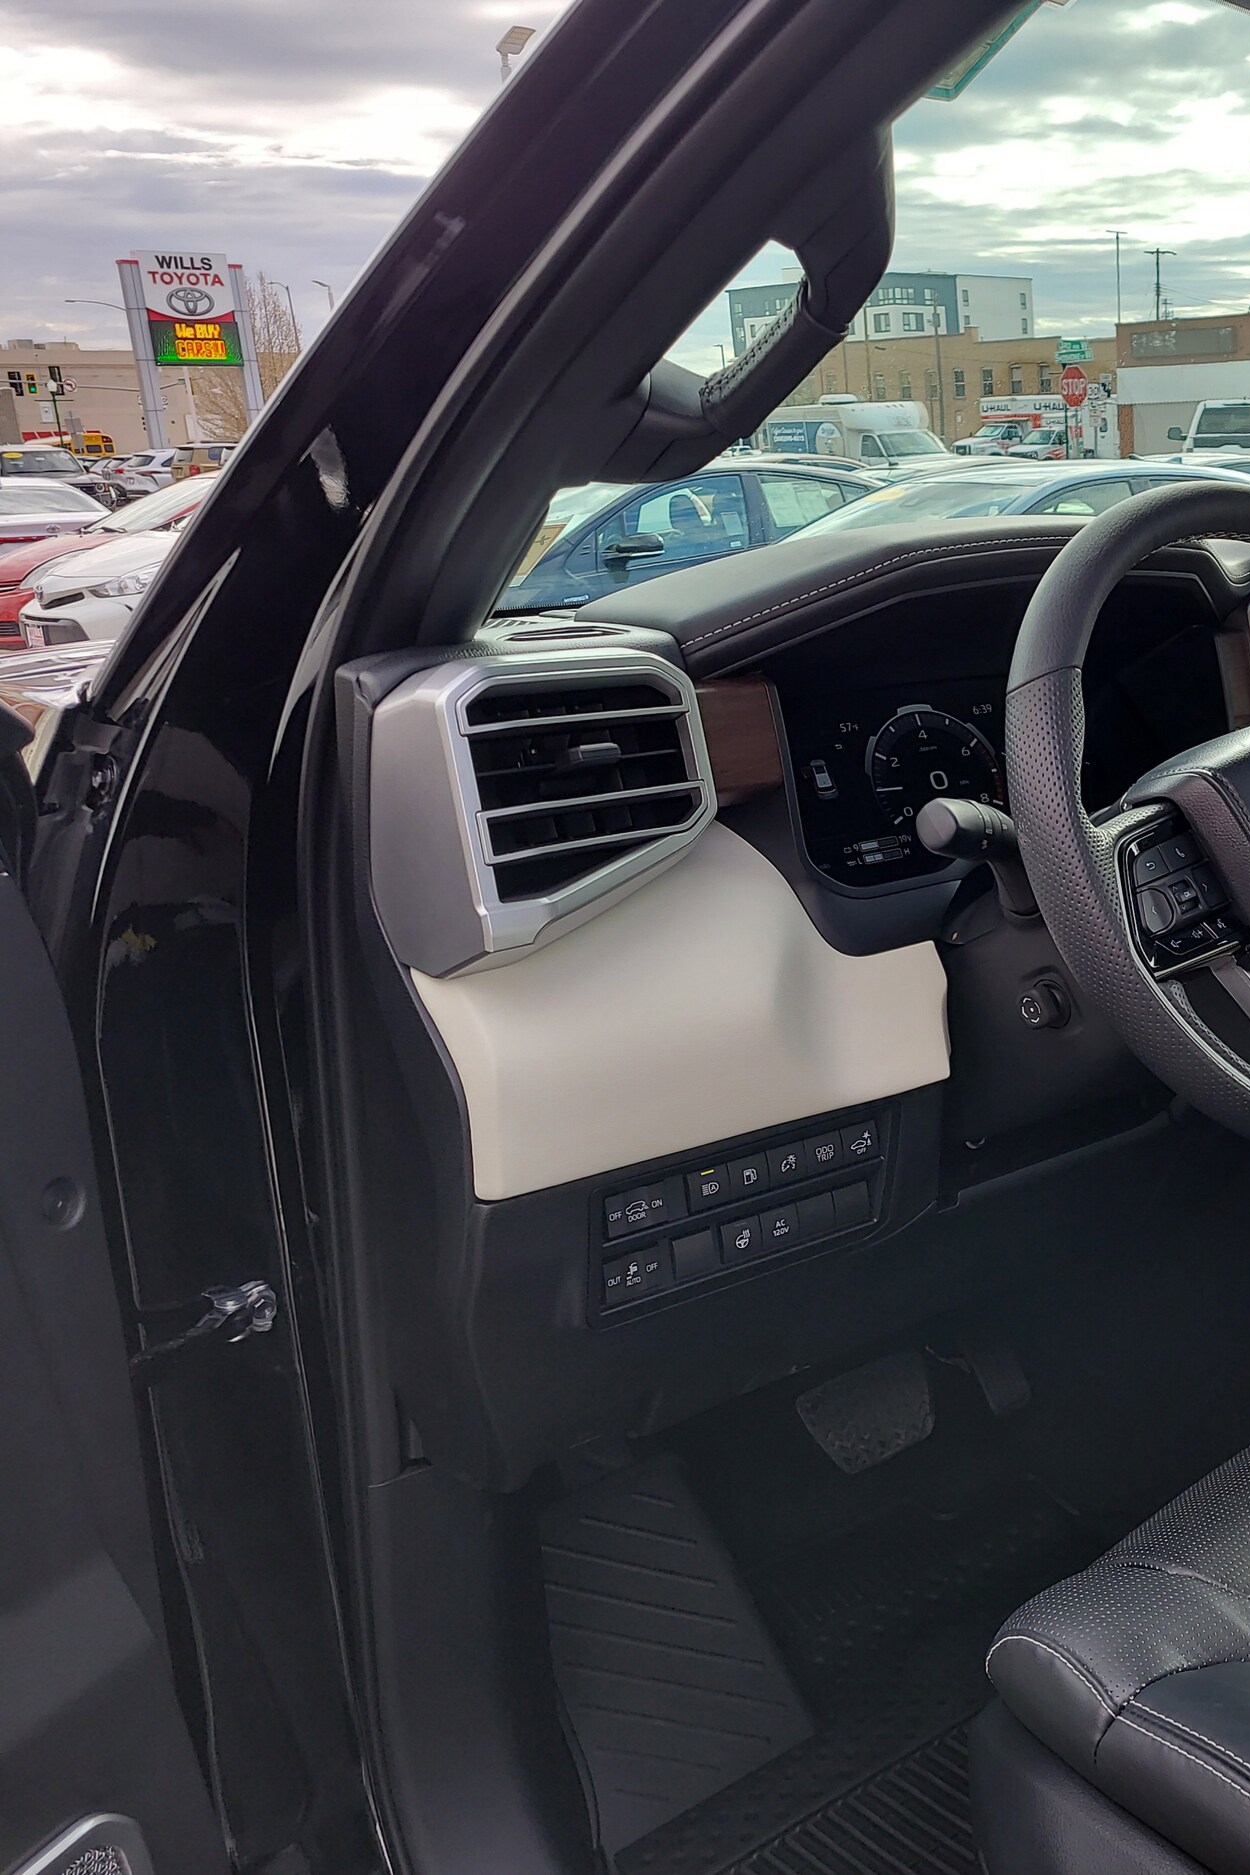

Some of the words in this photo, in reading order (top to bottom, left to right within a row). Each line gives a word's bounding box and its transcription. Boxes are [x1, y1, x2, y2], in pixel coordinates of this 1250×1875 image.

[154, 255, 213, 271] WILLS
[147, 271, 225, 287] TOYOTA
[194, 323, 221, 338] BUY
[1062, 379, 1086, 395] STOP
[972, 704, 993, 715] 6:39
[918, 730, 928, 739] 4
[961, 747, 970, 756] 6
[889, 757, 900, 767] 2
[930, 771, 948, 790] 0
[980, 793, 990, 802] 8
[903, 806, 914, 817] 0
[853, 843, 859, 851] 9
[898, 835, 912, 844] 19V
[815, 1144, 834, 1156] ODO
[856, 1147, 867, 1155] OFF
[817, 1151, 835, 1162] TRIP
[609, 1211, 623, 1222] OFF
[651, 1199, 663, 1208] ON
[628, 1211, 647, 1223] DOOR
[775, 1219, 786, 1228] AC
[772, 1226, 790, 1237] 120V
[607, 1275, 622, 1287] OUT
[646, 1262, 659, 1272] OFF
[626, 1276, 642, 1287] AUTO
